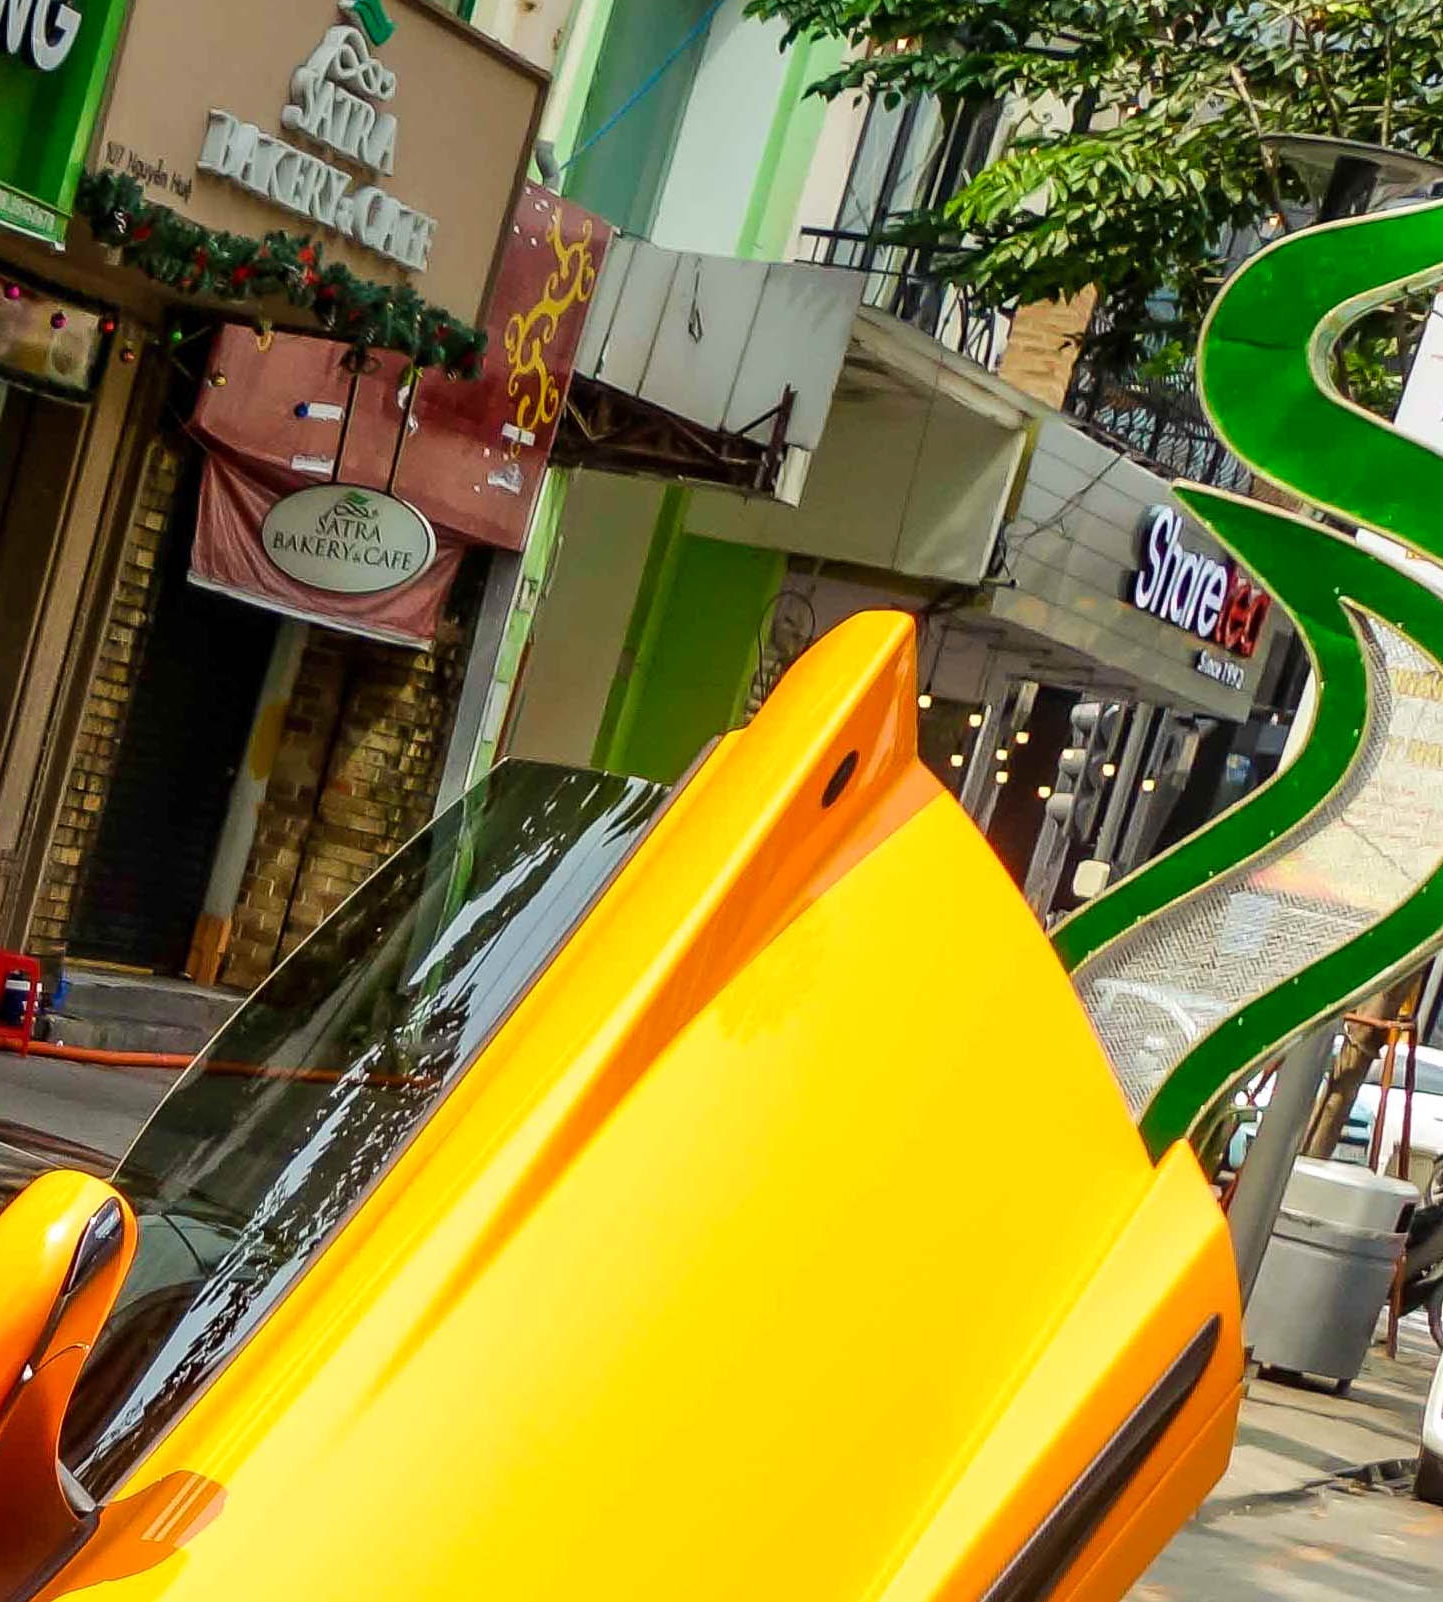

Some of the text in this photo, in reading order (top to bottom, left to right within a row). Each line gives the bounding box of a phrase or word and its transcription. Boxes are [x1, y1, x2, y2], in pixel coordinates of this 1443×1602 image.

[282, 80, 397, 177] SATRA
[197, 106, 352, 229] BAKERY
[352, 185, 437, 273] CAFE
[273, 531, 353, 563] BAKERY
[363, 546, 414, 572] CAFE
[316, 514, 382, 544] SATRA
